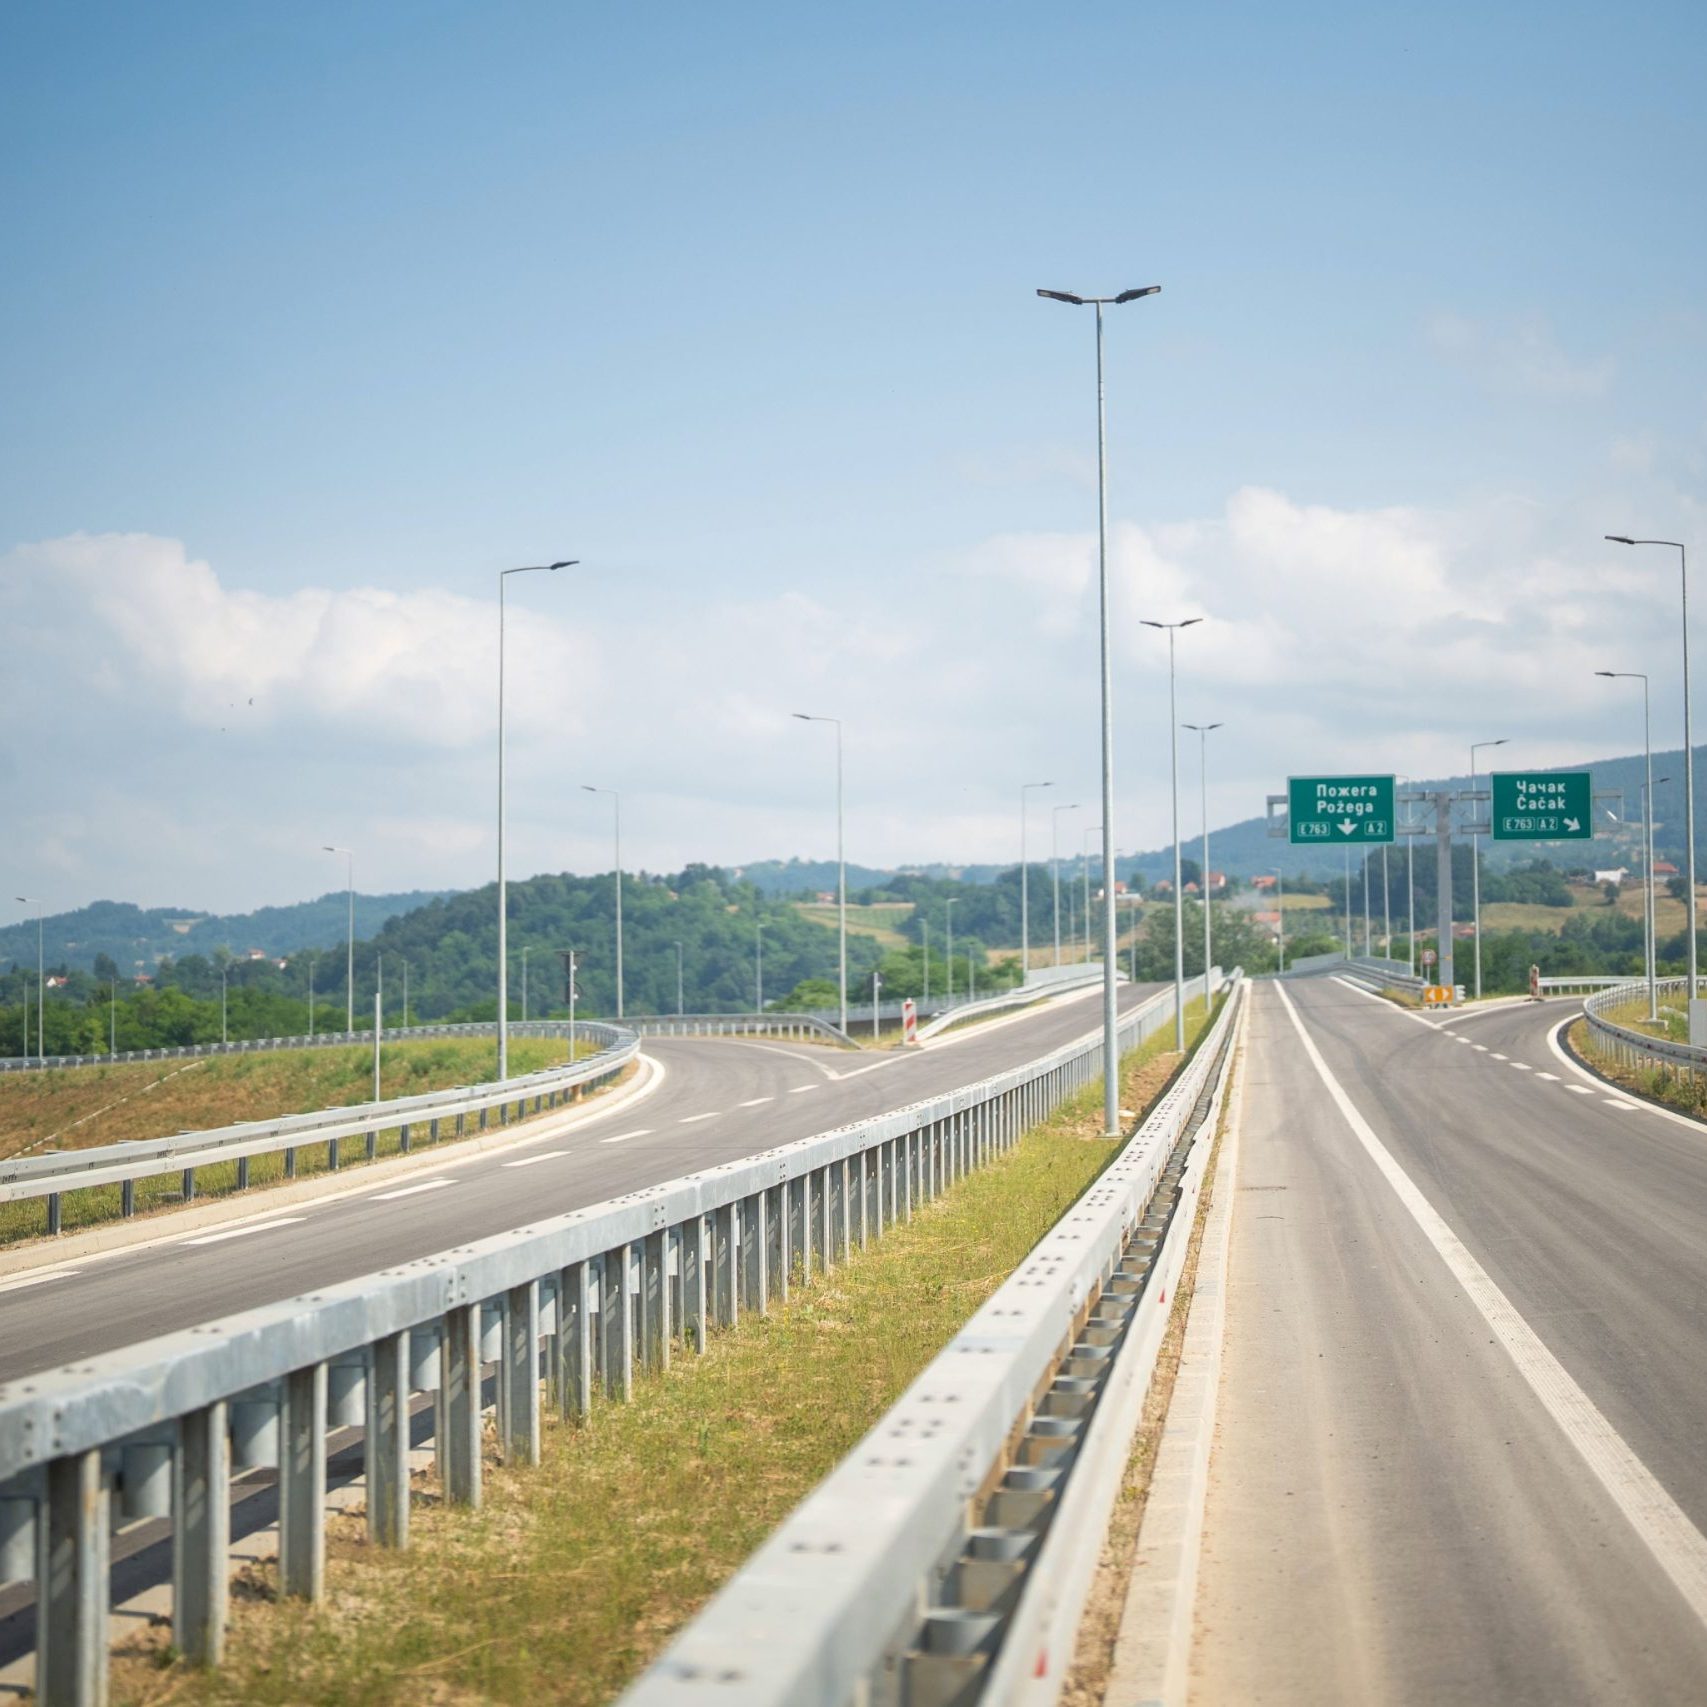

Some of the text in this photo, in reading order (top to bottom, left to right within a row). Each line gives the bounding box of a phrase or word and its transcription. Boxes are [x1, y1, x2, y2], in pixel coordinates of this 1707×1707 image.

[1316, 783, 1377, 797] Пожега
[1516, 780, 1566, 793] Чачак
[1516, 794, 1566, 810] Čačak
[1317, 800, 1374, 817] Požega
[1300, 823, 1328, 835] E 763
[1368, 822, 1384, 833] A 2
[1506, 819, 1533, 829] E 763
[1540, 818, 1555, 829] A 2
